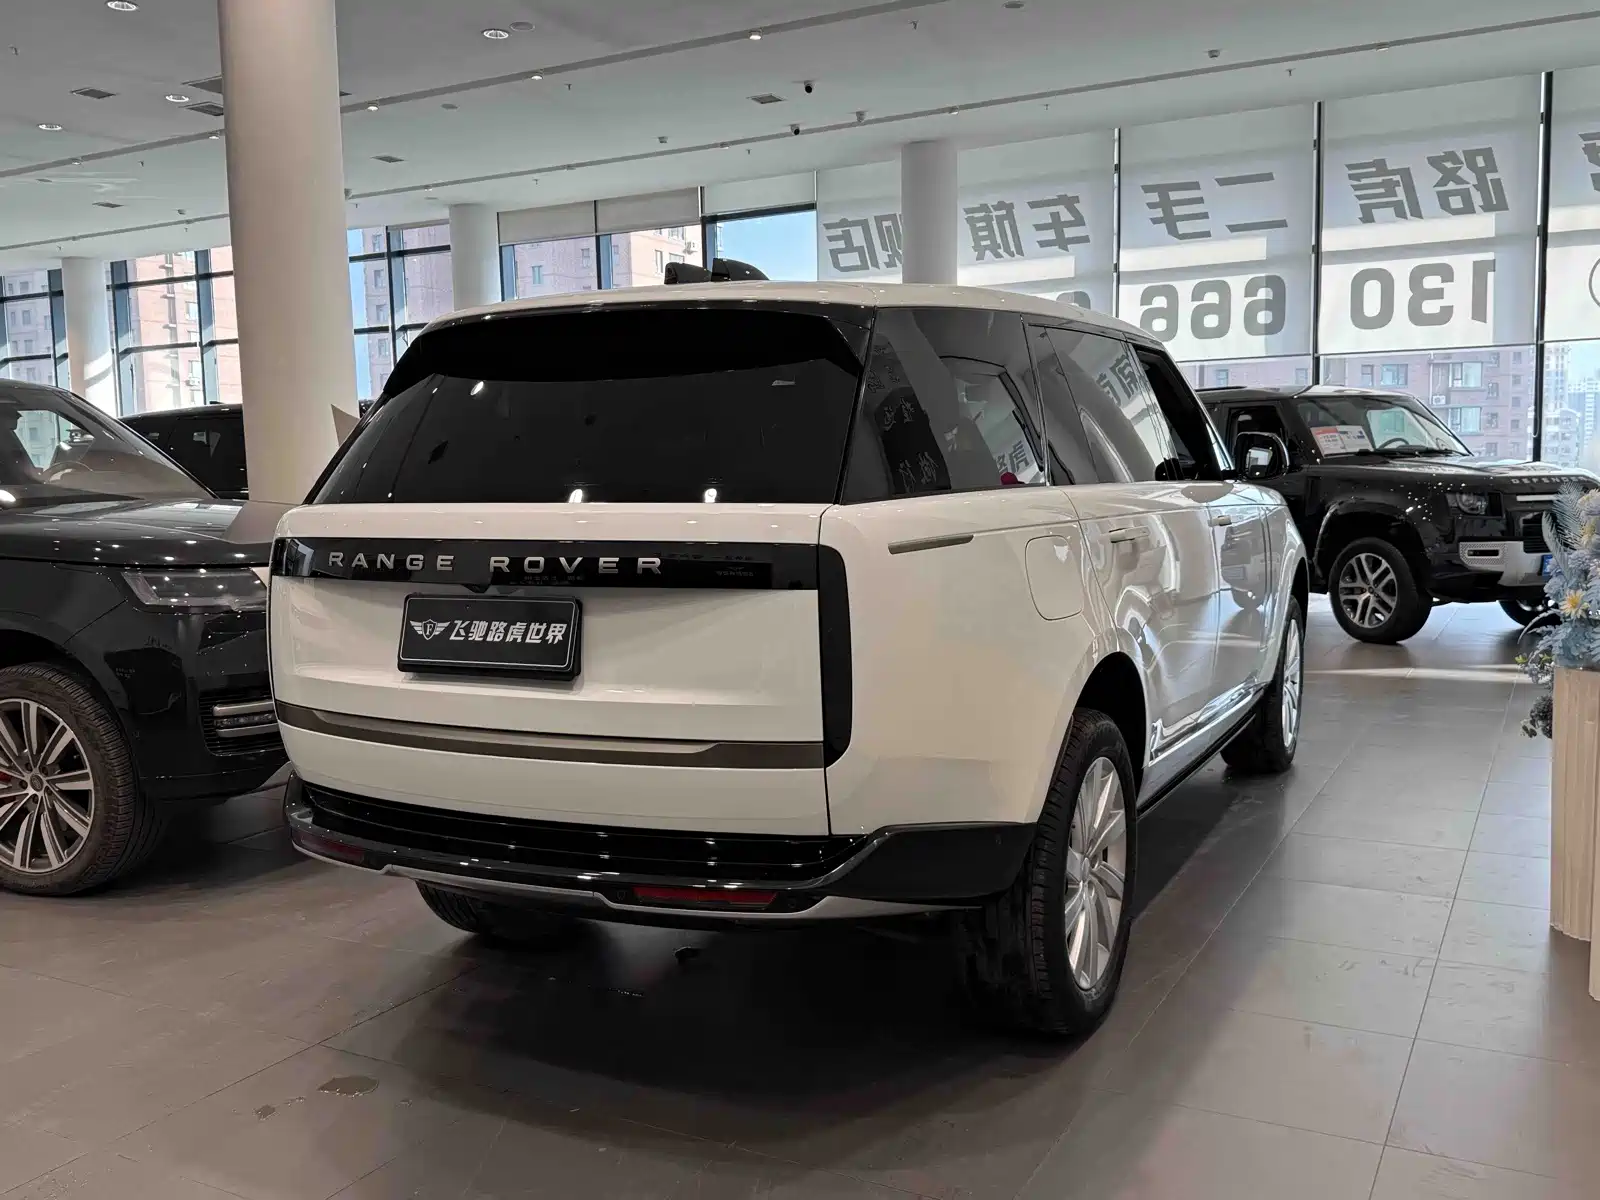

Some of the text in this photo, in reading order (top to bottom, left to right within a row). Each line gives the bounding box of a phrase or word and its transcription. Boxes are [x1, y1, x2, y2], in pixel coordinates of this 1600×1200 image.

[328, 551, 662, 575] RANGE ROVER
[449, 620, 568, 645] 飞驰路虎世界
